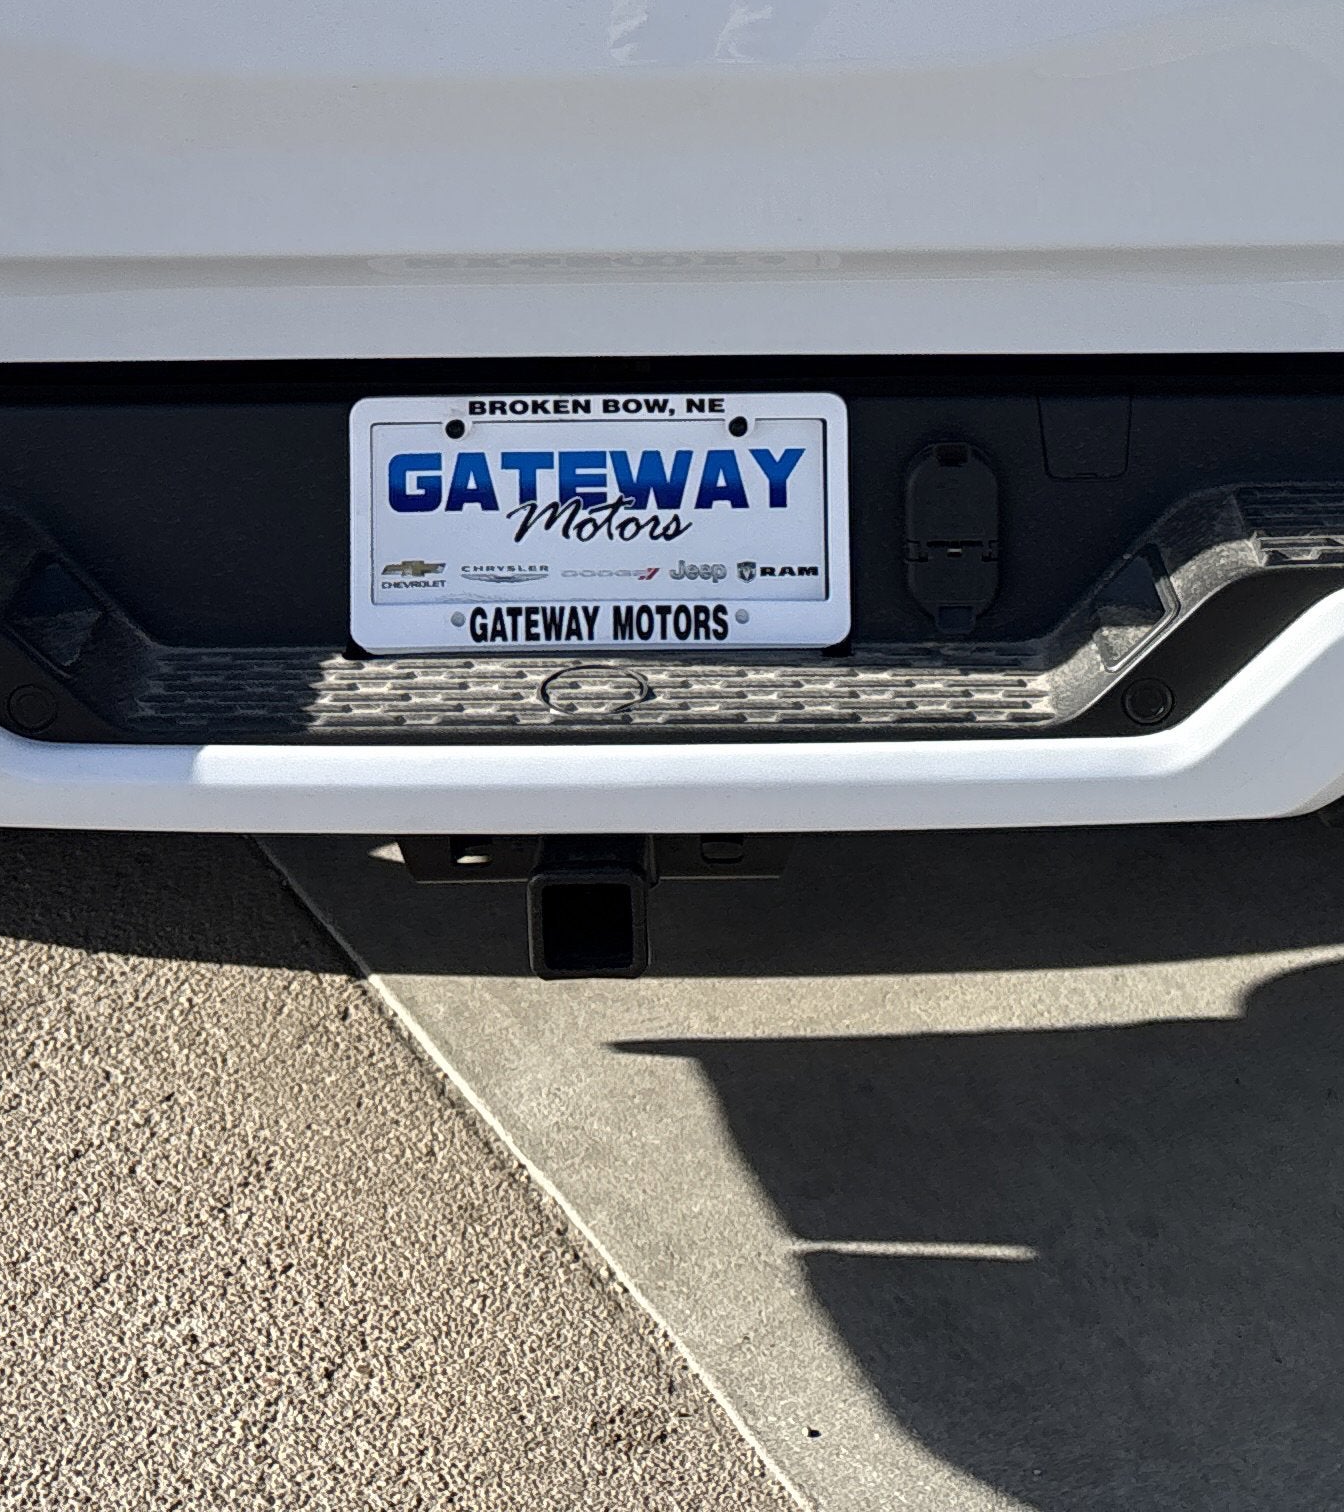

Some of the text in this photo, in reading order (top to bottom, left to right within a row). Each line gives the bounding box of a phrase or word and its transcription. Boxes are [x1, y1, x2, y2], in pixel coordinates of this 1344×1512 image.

[468, 397, 726, 417] BROKEN BOW, NE
[388, 448, 806, 513] GATEWAY
[506, 495, 693, 544] Motors
[461, 565, 549, 573] CHRYSLER
[669, 559, 727, 583] Jeep
[759, 566, 819, 577] RAM
[381, 579, 447, 589] CHEVROLET
[469, 604, 729, 643] GATEWAY MOTORS
